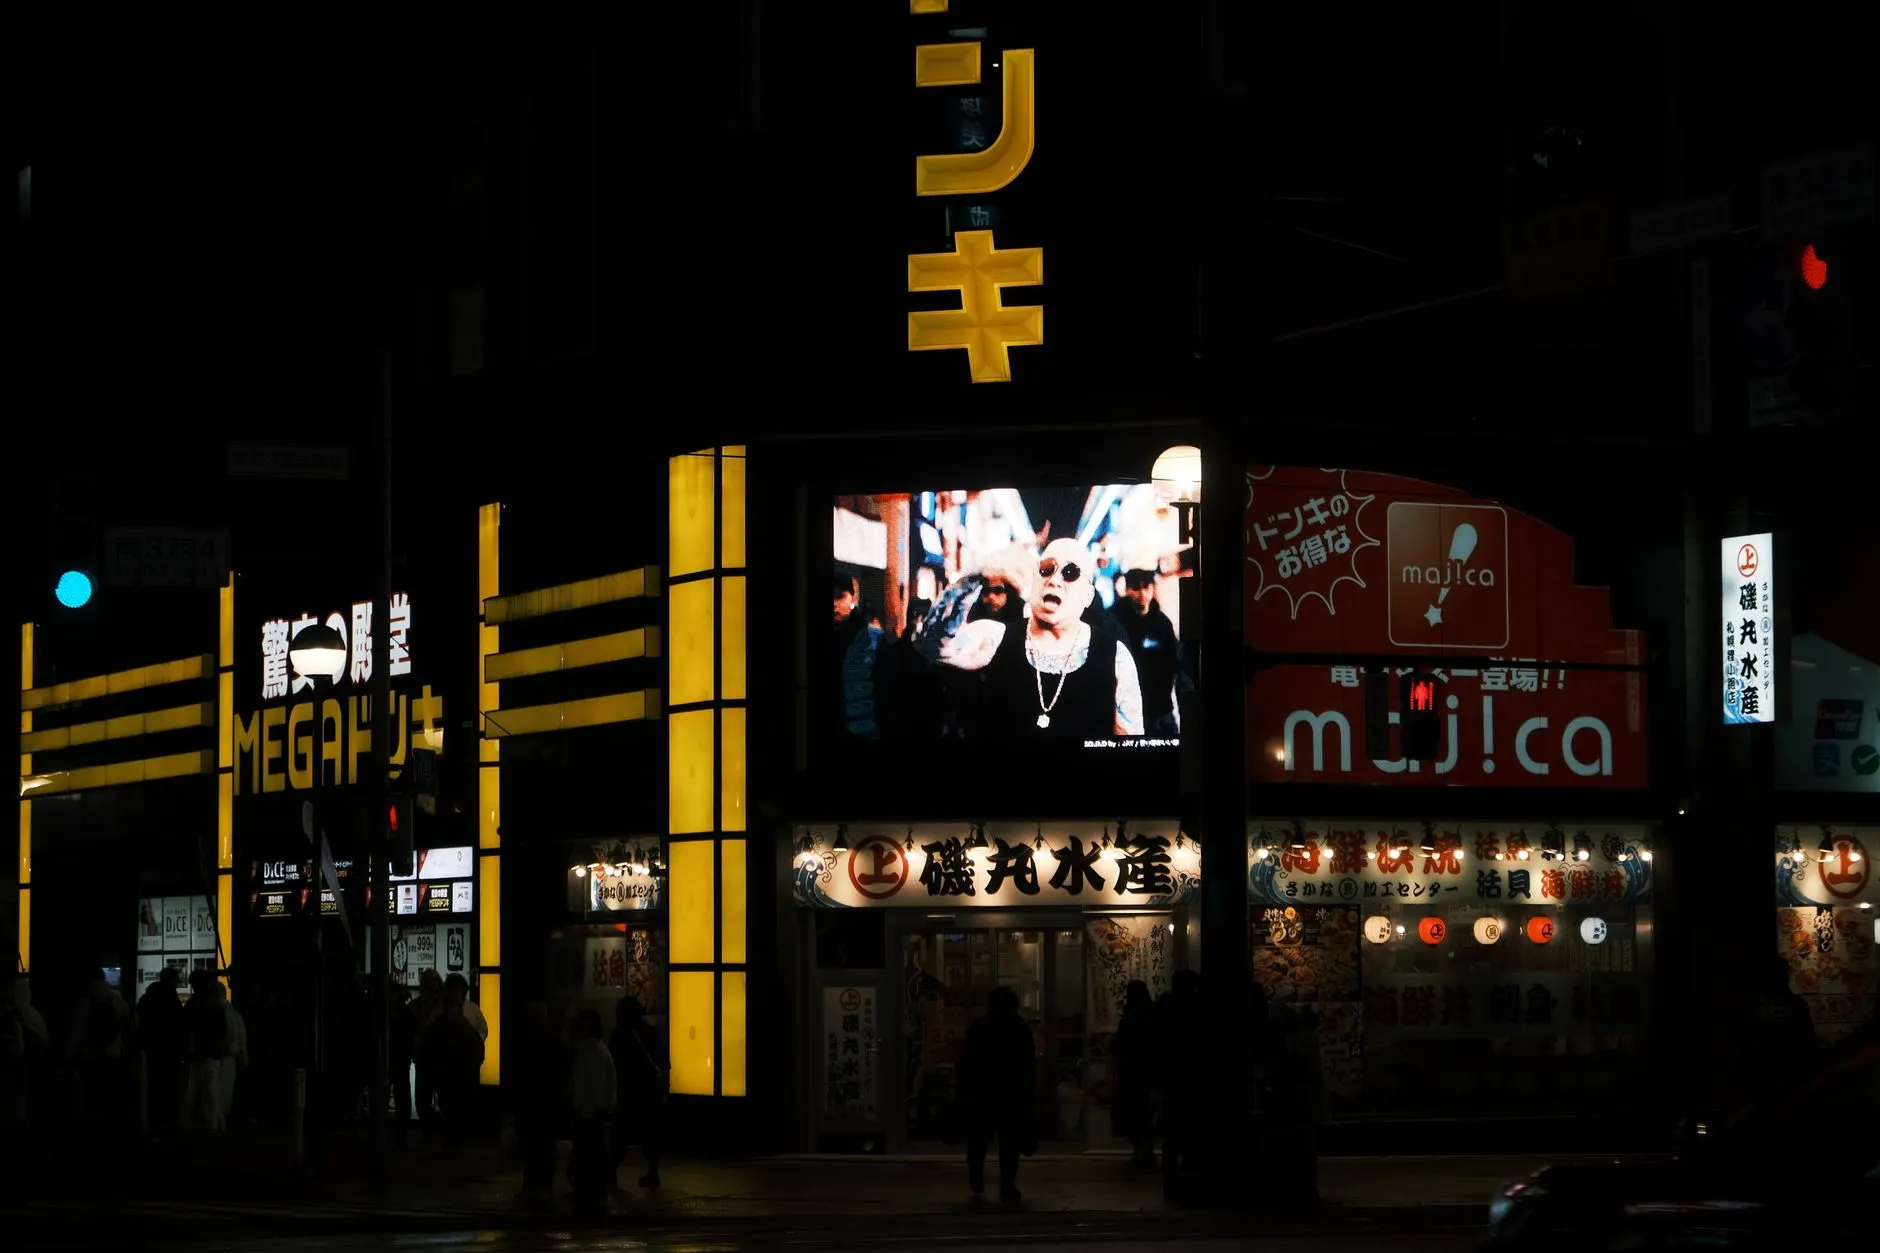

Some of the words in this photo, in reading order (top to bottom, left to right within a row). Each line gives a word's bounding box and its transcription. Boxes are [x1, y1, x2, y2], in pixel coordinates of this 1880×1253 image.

[908, 0, 1043, 383] ンキ
[1252, 493, 1350, 551] ドンキの
[1273, 525, 1352, 580] お得な
[1740, 582, 1759, 715] 磯丸水産
[918, 834, 1173, 896] 磯丸水産
[1477, 869, 1531, 899] 活貝
[1541, 869, 1623, 899] 海鮮丼
